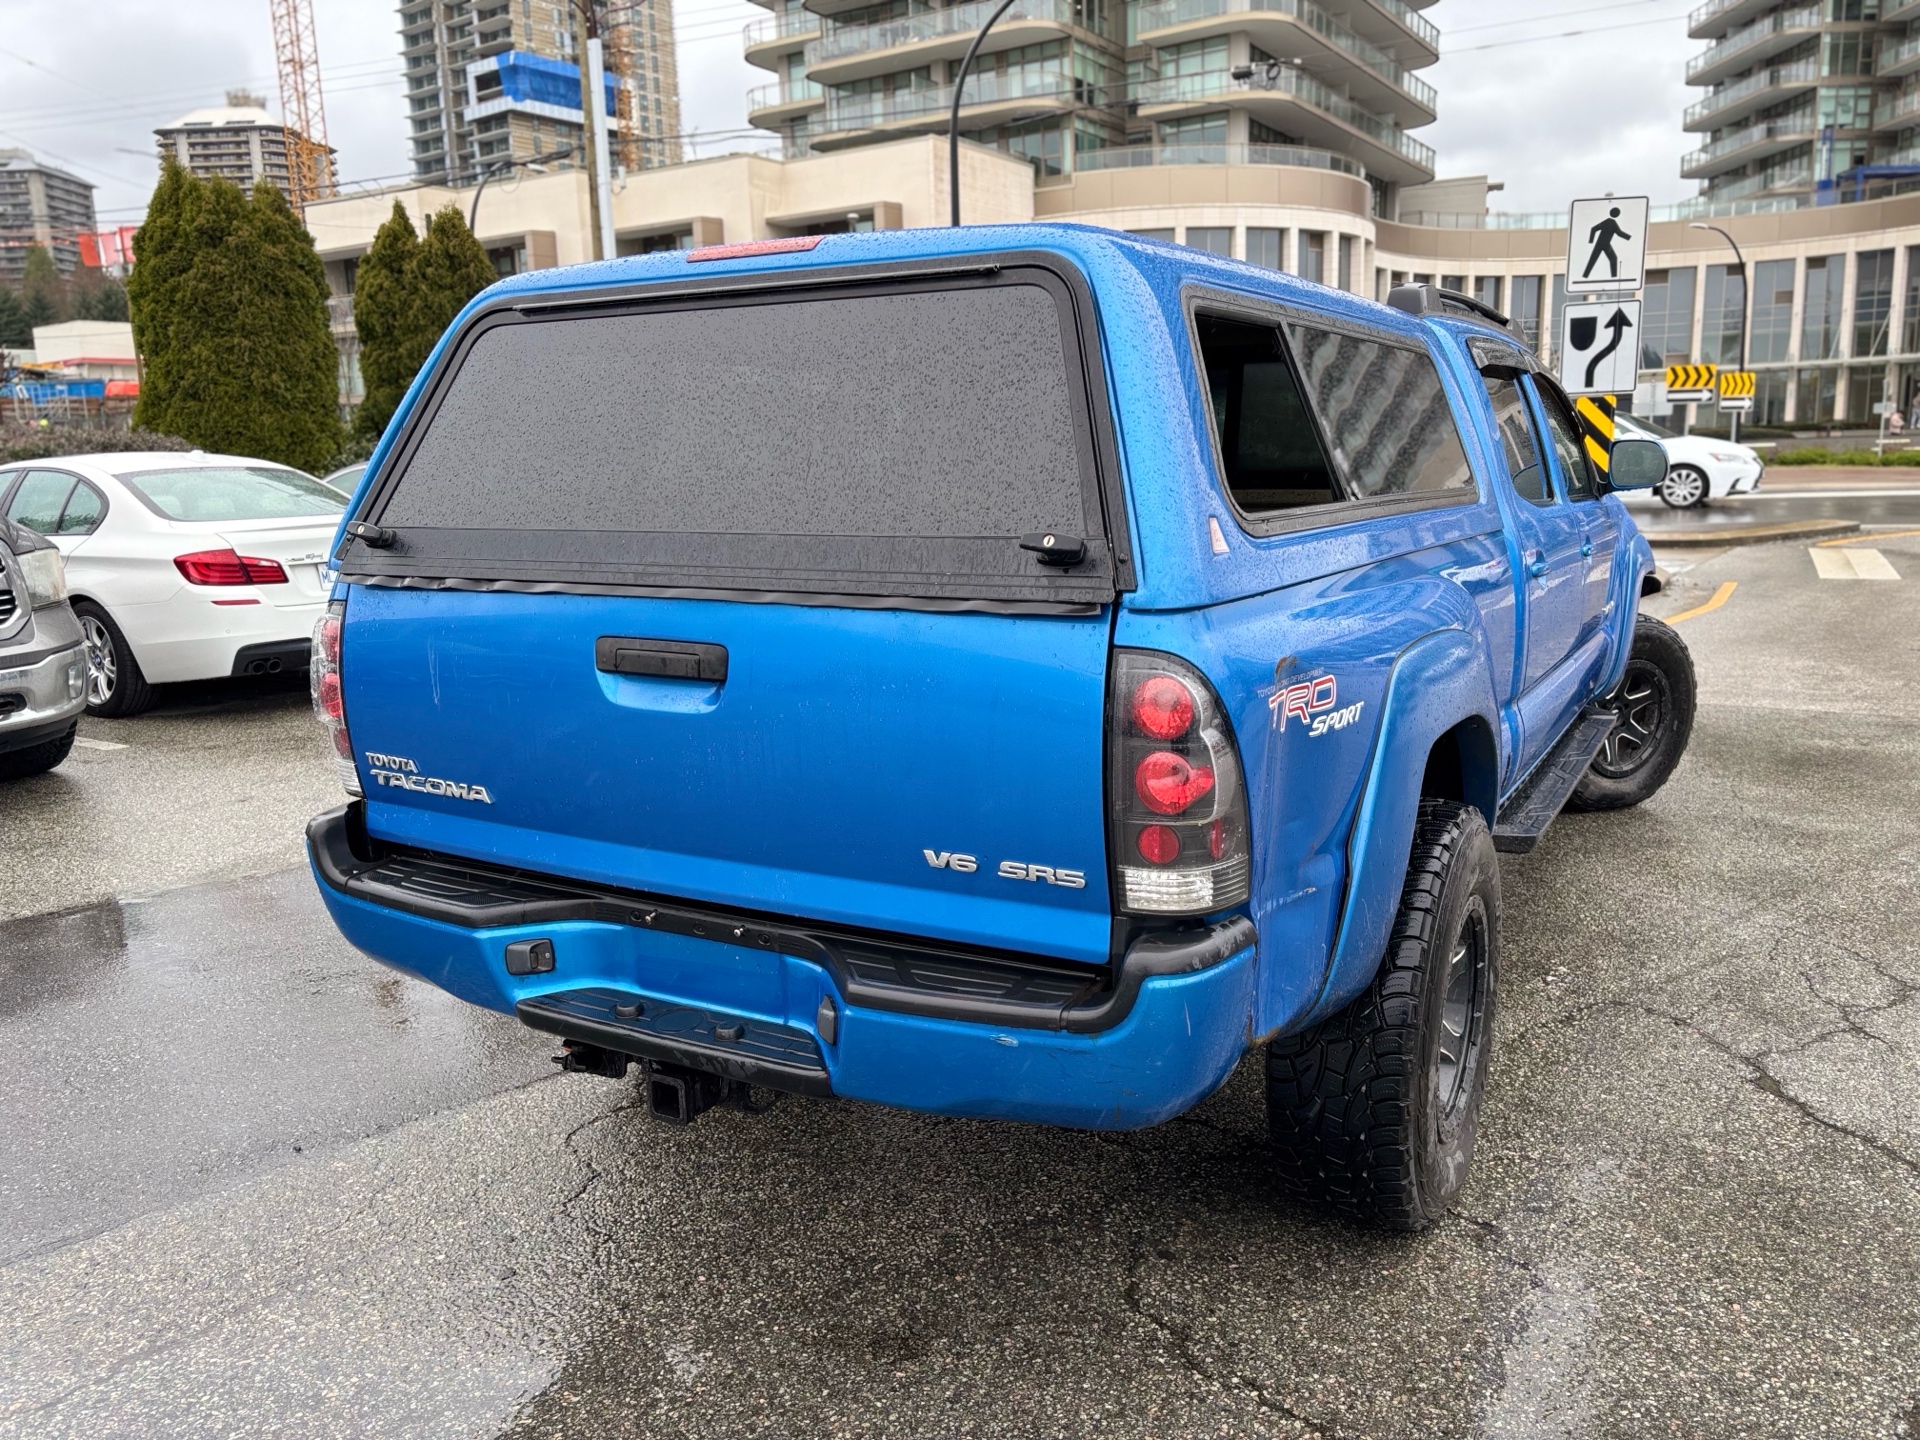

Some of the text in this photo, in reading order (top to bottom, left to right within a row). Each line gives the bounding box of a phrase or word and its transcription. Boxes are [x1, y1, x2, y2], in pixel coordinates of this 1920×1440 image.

[1290, 667, 1325, 684] DEVELOPMENT
[1268, 674, 1336, 734] TRD
[1308, 700, 1364, 737] SPORT
[364, 751, 420, 774] TOYOTA
[369, 768, 493, 805] TACOMA
[923, 849, 1087, 889] V6 SR5
